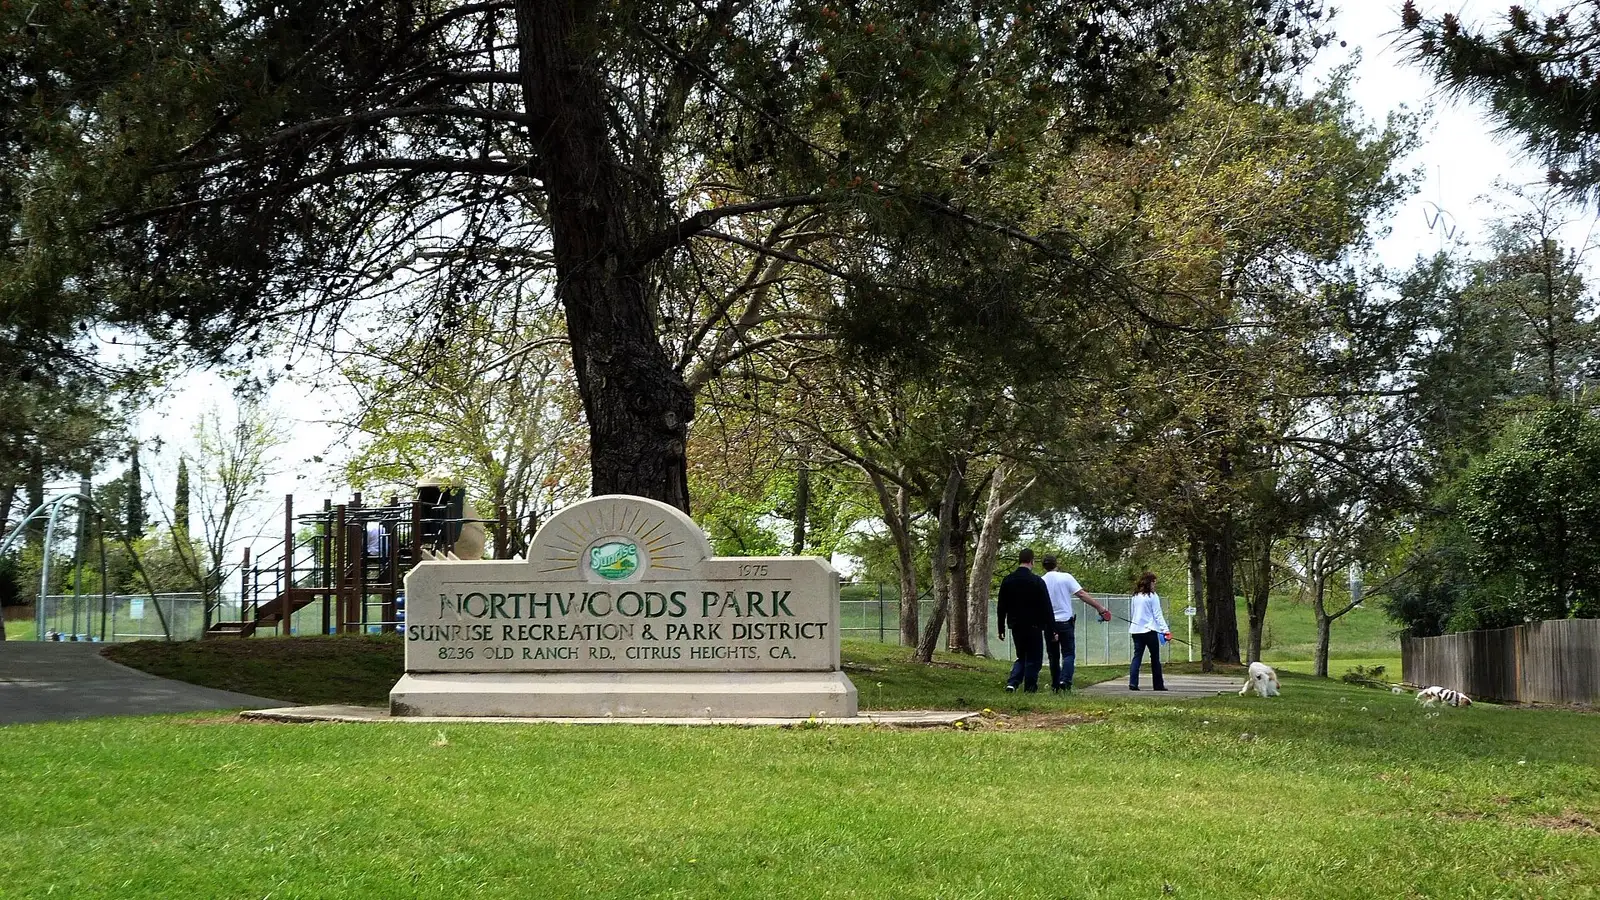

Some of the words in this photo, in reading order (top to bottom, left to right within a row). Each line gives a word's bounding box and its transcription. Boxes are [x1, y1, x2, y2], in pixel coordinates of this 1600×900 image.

[590, 543, 637, 570] Sunrise
[738, 564, 769, 577] 1975
[439, 591, 687, 619] NORTHWOODS
[701, 590, 795, 618] PARK
[408, 624, 494, 642] SUNRISE
[502, 623, 634, 641] RECREATION
[641, 623, 659, 641] &
[666, 623, 723, 640] PARK
[732, 622, 828, 640] DISTRICT
[438, 647, 474, 660] 8236
[483, 647, 514, 660] OLD
[522, 647, 579, 660] RANCH
[625, 646, 681, 660] CITRUS
[690, 646, 761, 661] HEIGHTS,
[769, 646, 796, 660] CA.
